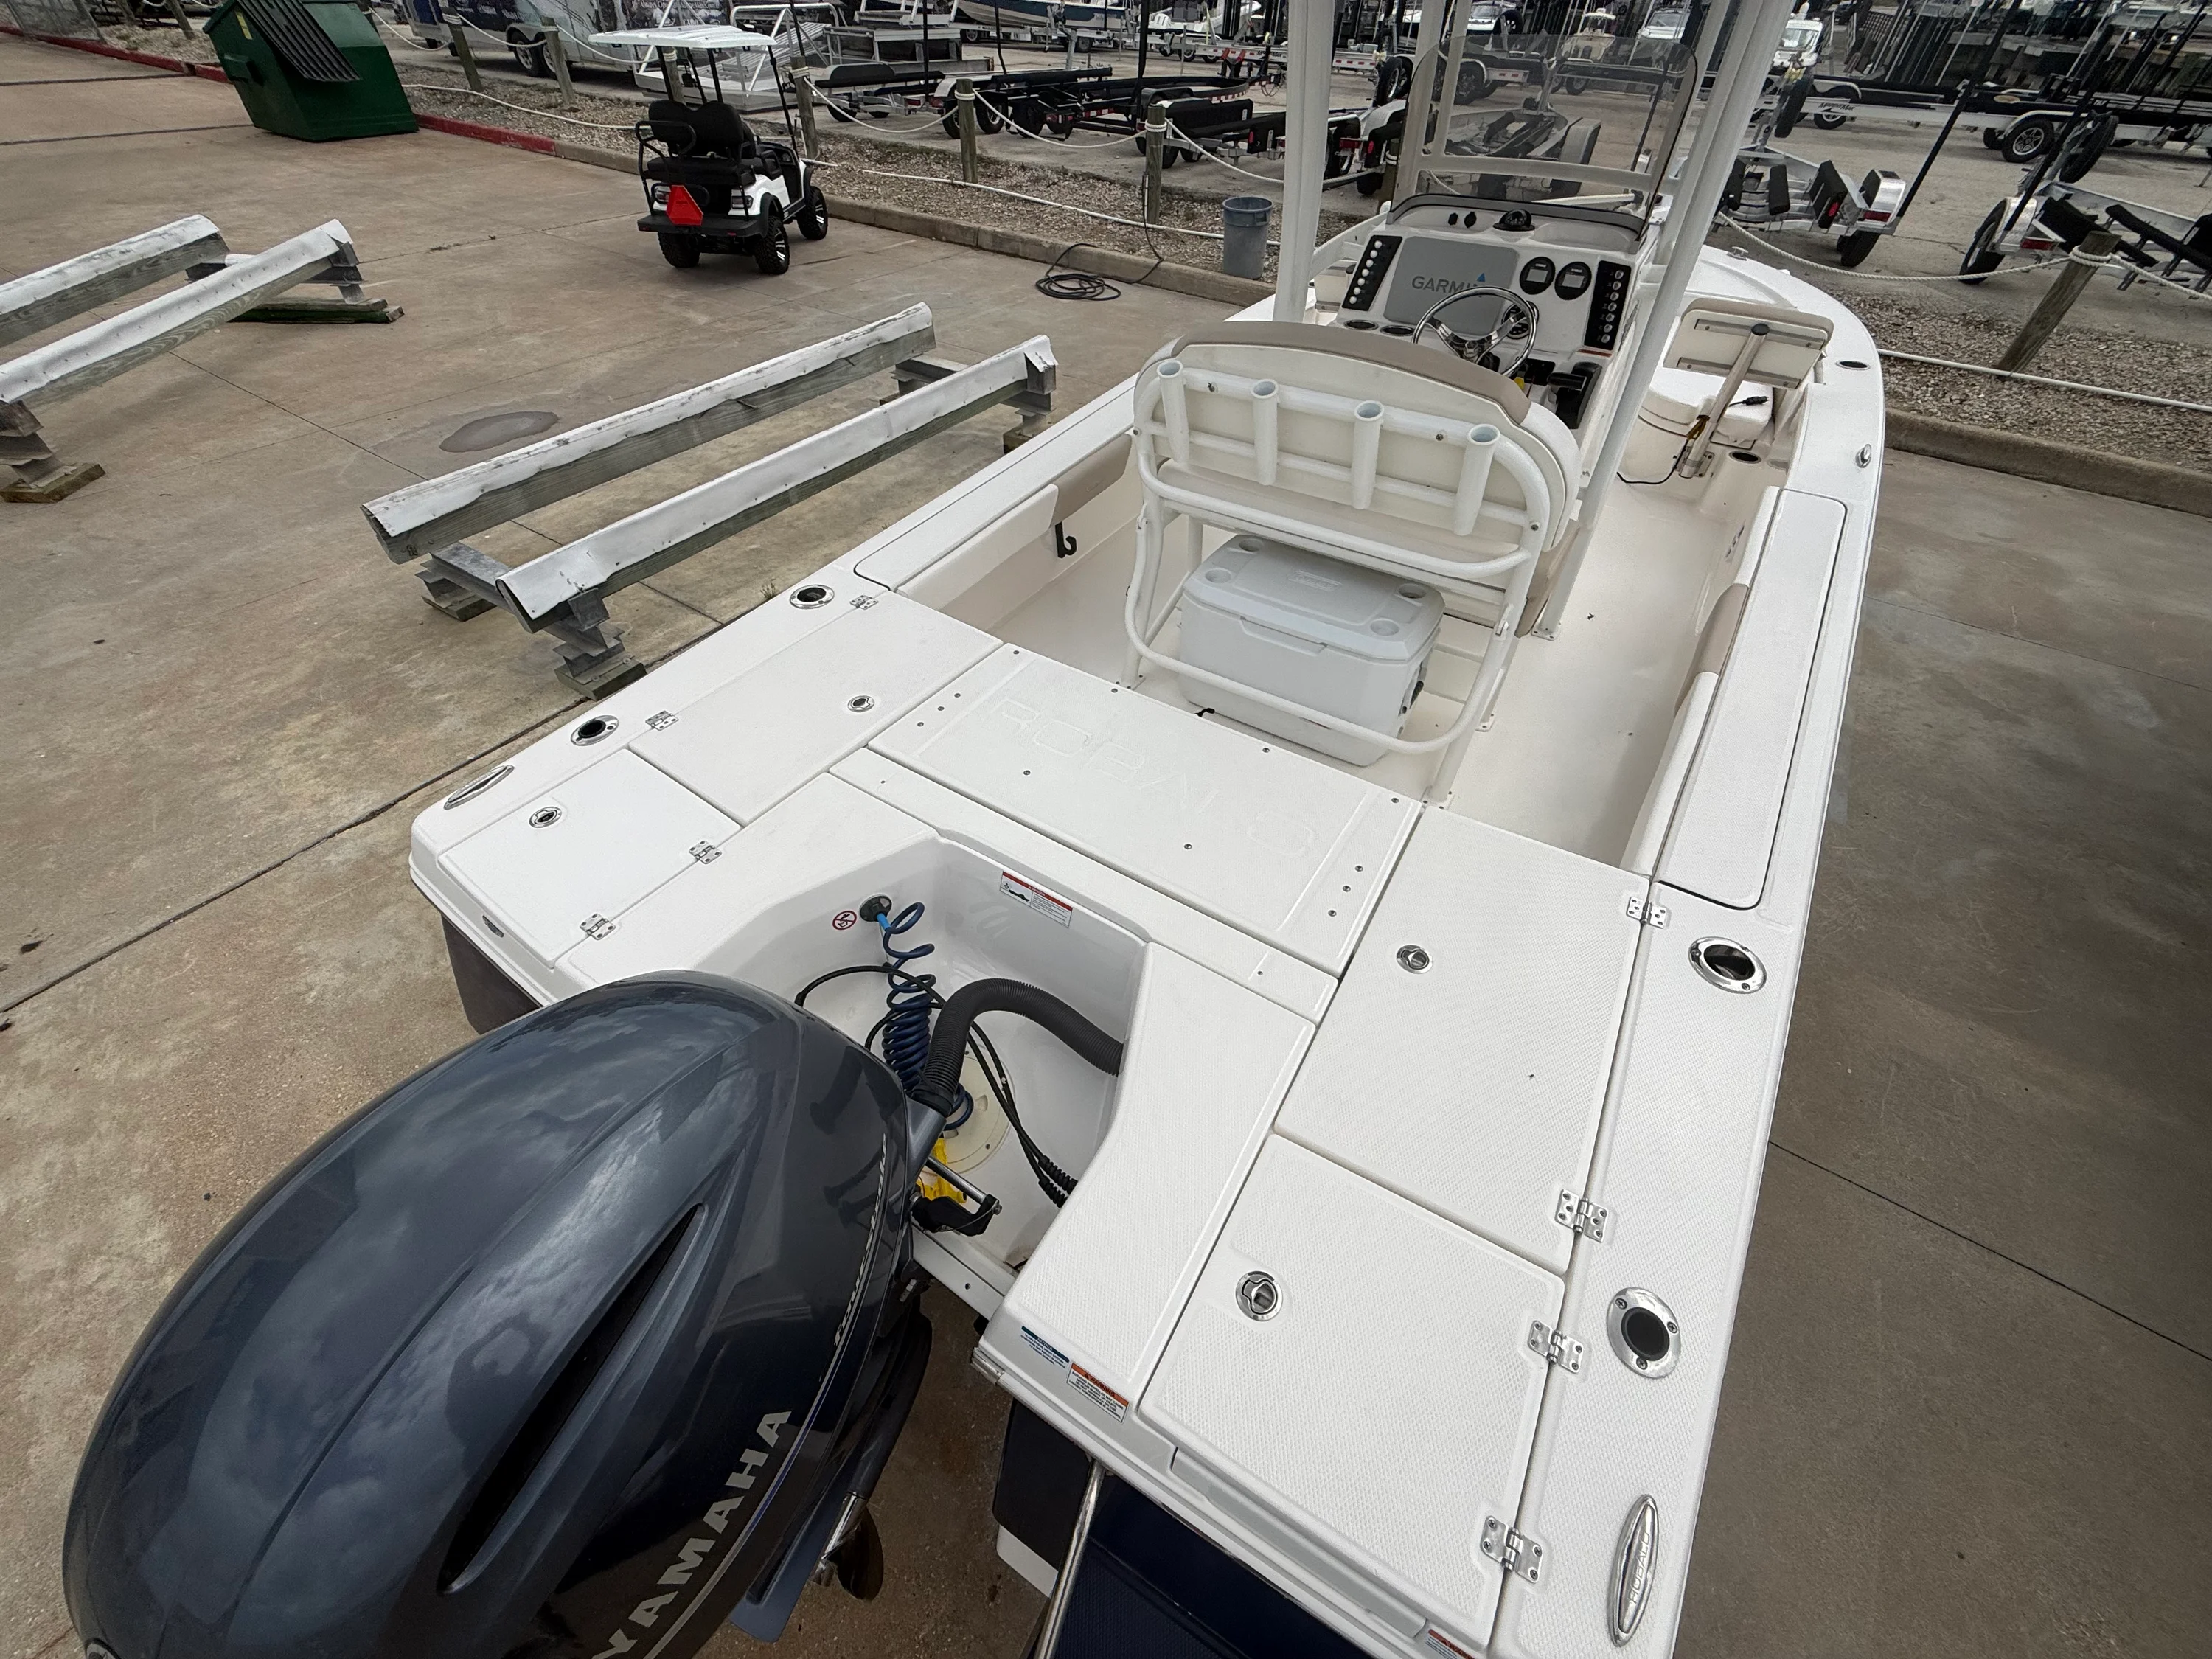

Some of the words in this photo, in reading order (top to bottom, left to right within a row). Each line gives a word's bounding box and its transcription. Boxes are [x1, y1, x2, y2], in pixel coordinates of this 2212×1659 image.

[1411, 275, 1485, 297] GARM
[591, 1411, 792, 1659] YAMAHA
[1629, 1532, 1651, 1604] ROBALO
